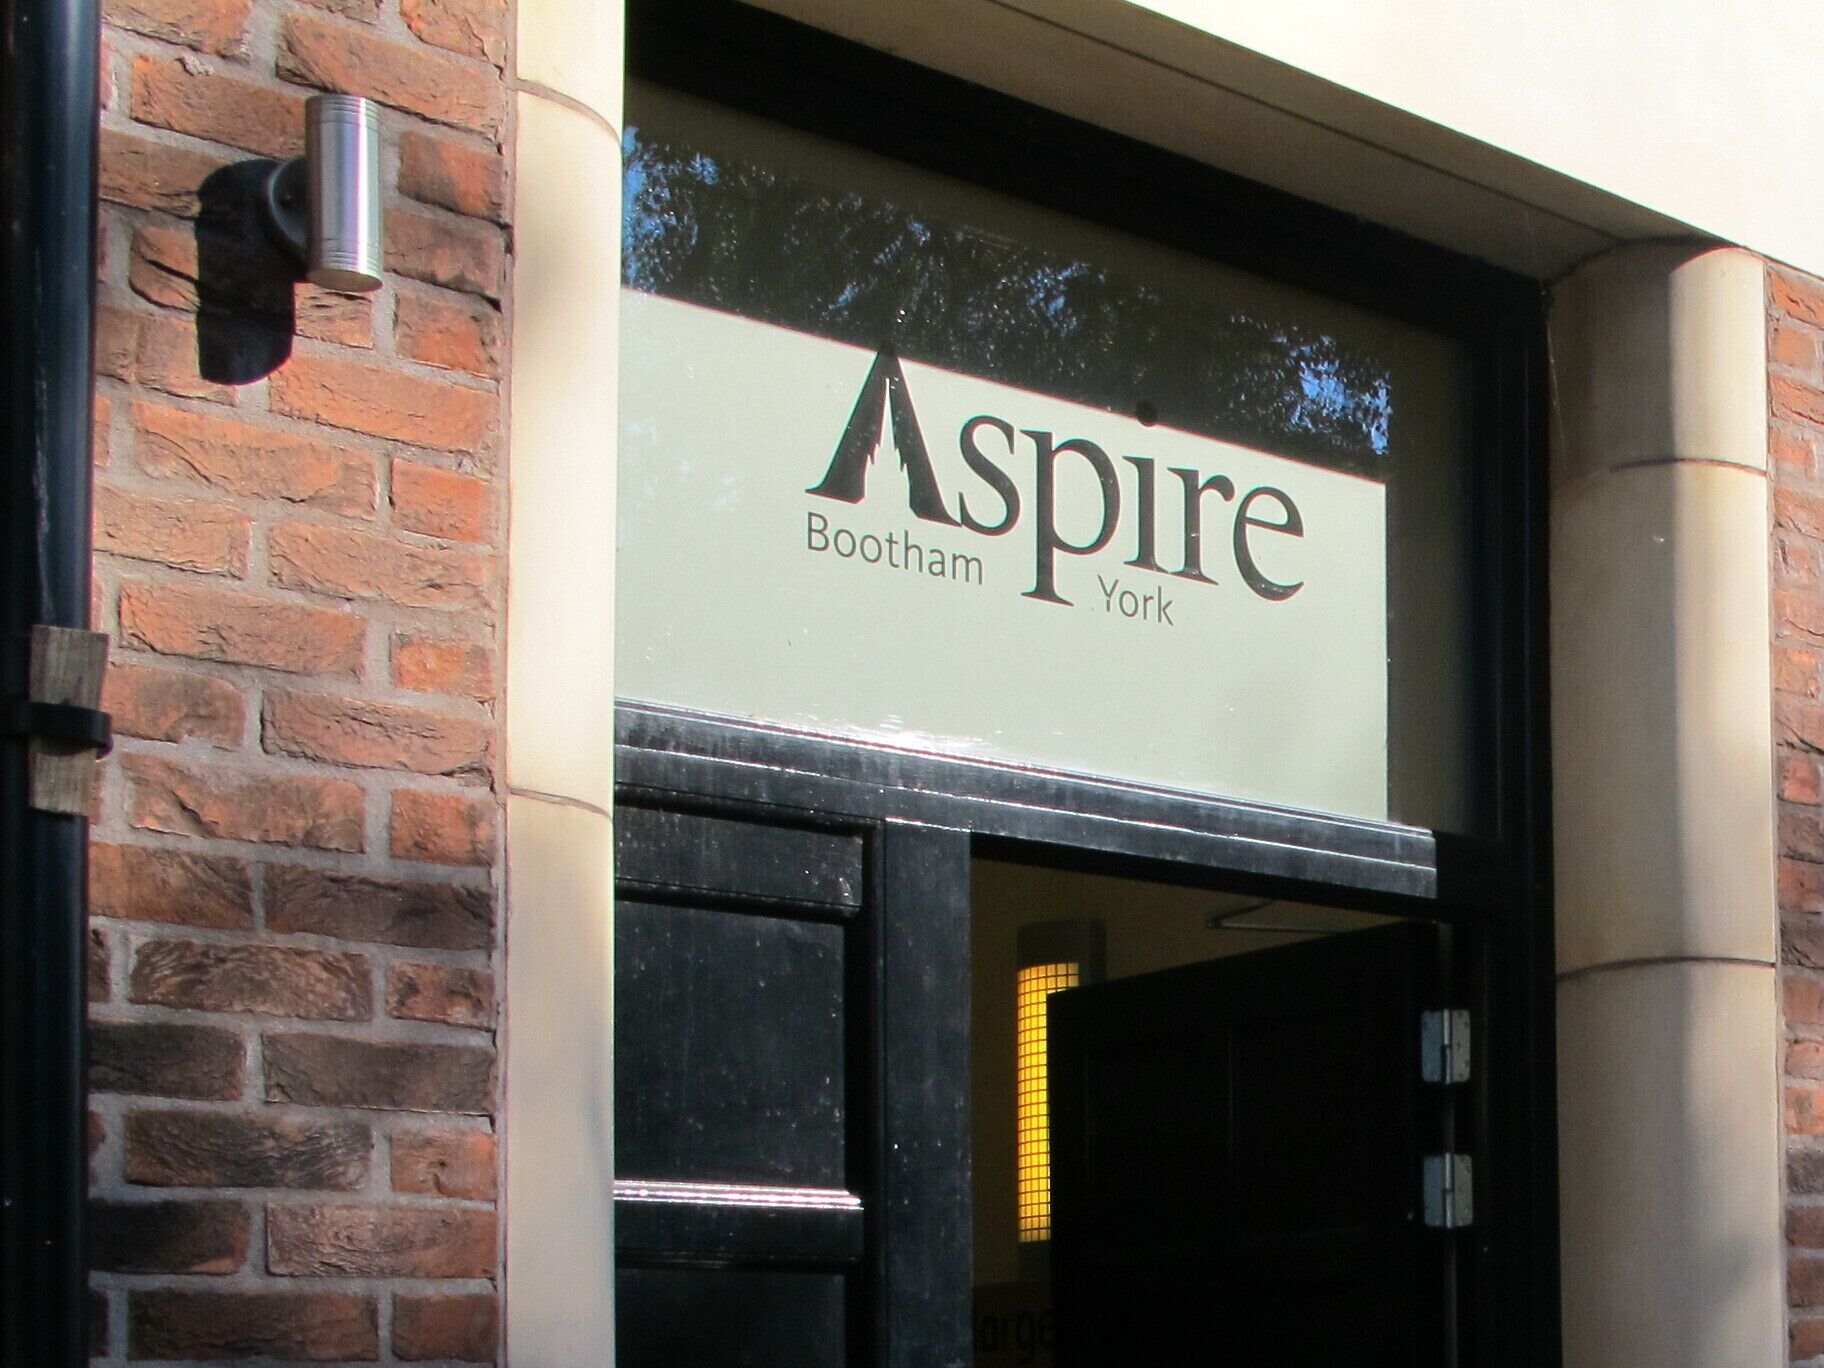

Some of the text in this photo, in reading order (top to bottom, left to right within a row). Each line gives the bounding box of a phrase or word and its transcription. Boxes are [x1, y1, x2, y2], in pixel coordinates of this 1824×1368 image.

[805, 348, 1304, 606] Aspire
[806, 510, 984, 586] Bootham
[1097, 572, 1175, 628] York
